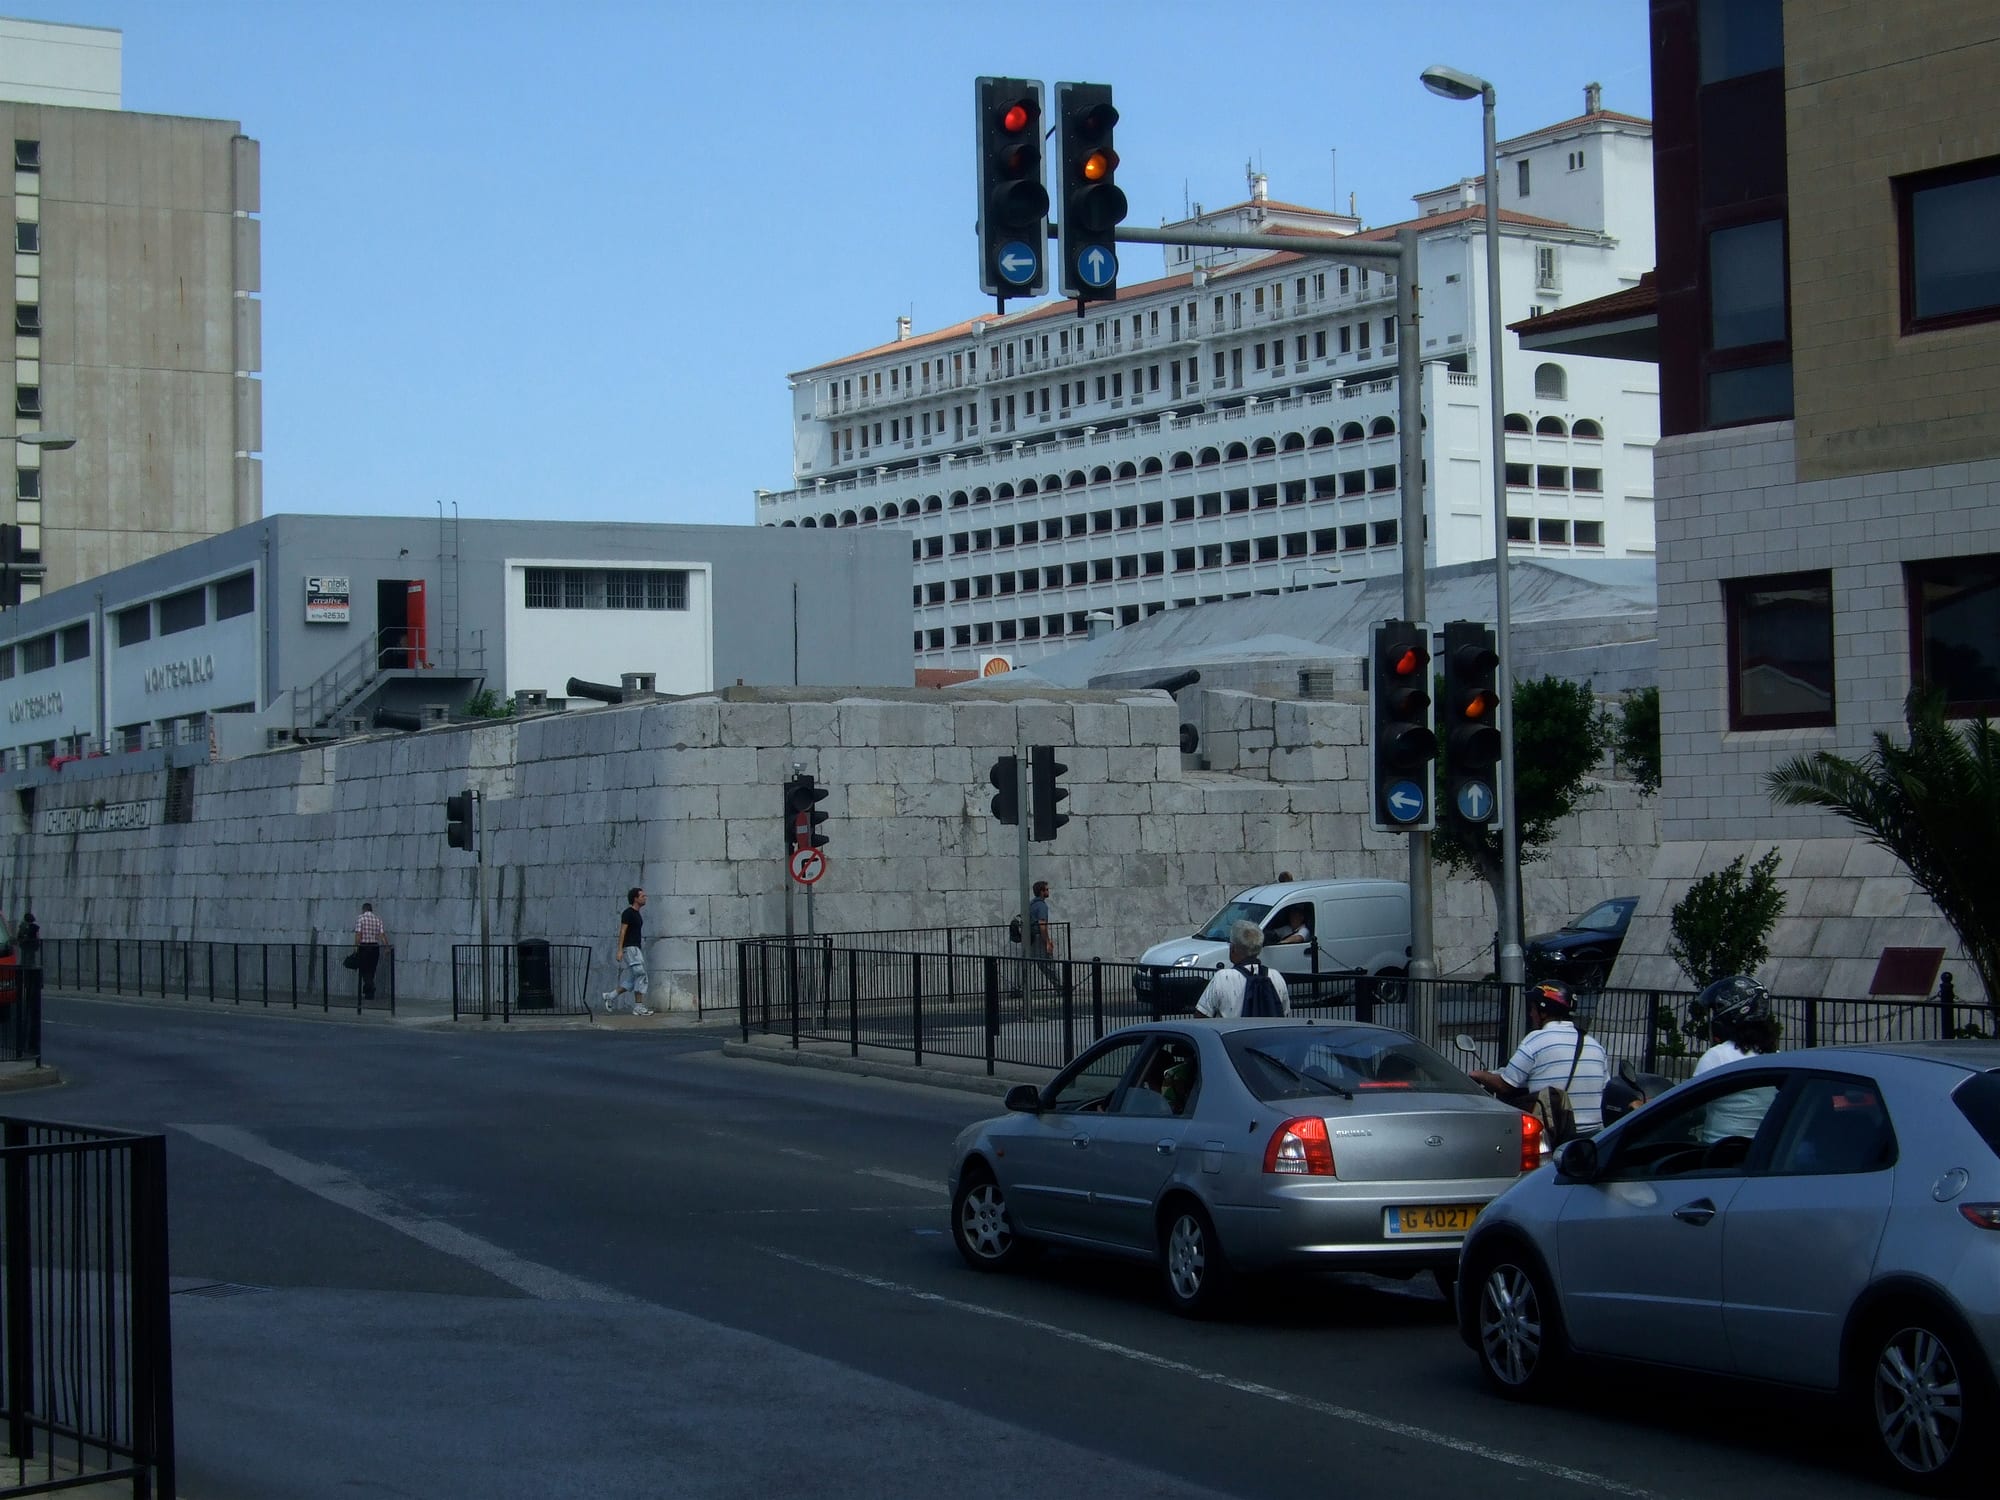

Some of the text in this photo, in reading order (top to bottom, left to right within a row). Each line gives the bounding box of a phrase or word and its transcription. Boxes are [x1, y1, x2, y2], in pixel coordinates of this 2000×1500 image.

[144, 654, 215, 696] MONTECARLO
[47, 808, 82, 833] CHATHAM
[1406, 1210, 1418, 1229] G
[1423, 1208, 1468, 1229] 4027
